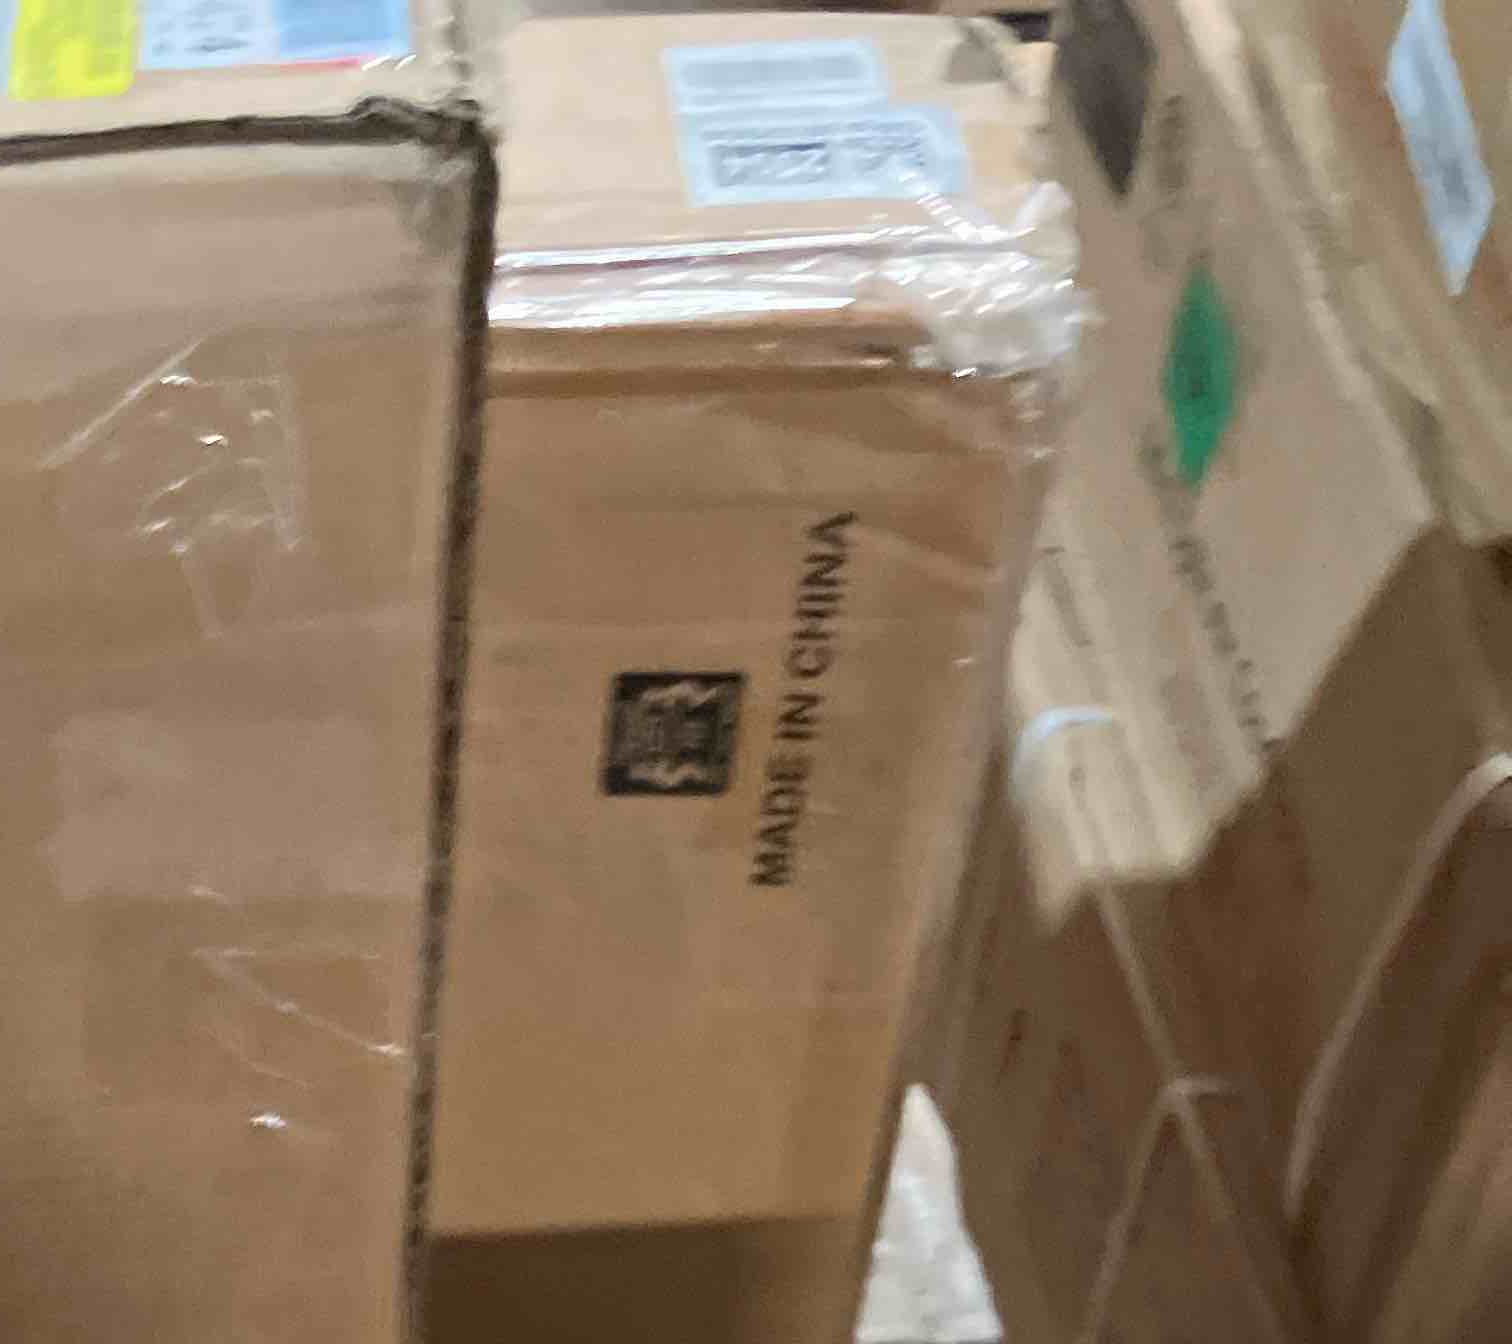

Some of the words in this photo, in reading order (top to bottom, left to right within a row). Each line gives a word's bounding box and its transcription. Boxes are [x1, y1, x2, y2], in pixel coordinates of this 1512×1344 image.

[786, 511, 859, 677] CHINA
[775, 694, 823, 739] IN
[748, 753, 814, 886] MADE
